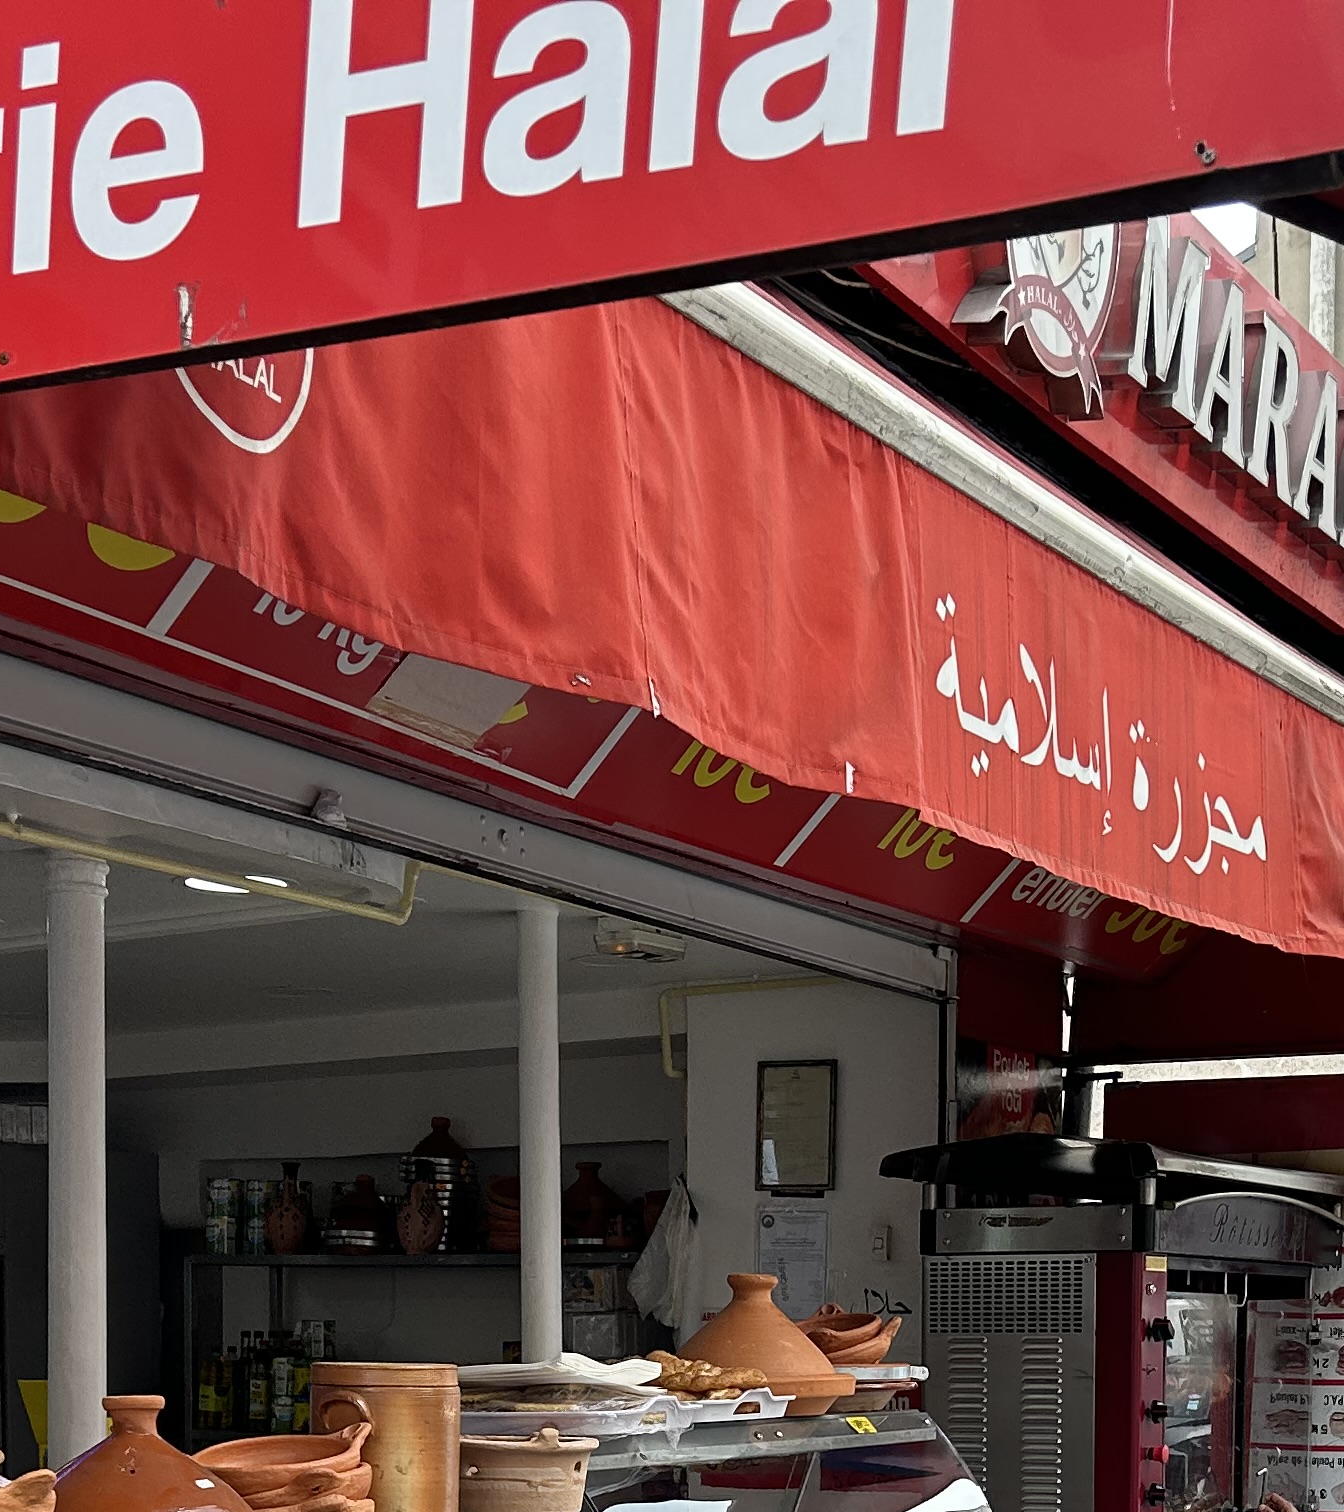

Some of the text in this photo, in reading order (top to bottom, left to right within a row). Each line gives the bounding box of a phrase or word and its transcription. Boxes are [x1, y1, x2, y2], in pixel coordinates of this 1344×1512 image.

[297, 0, 957, 229] Halal
[1027, 285, 1062, 315] HALAL
[935, 592, 1267, 875] مجزرة إسلامية
[993, 1048, 1030, 1082] Poulet
